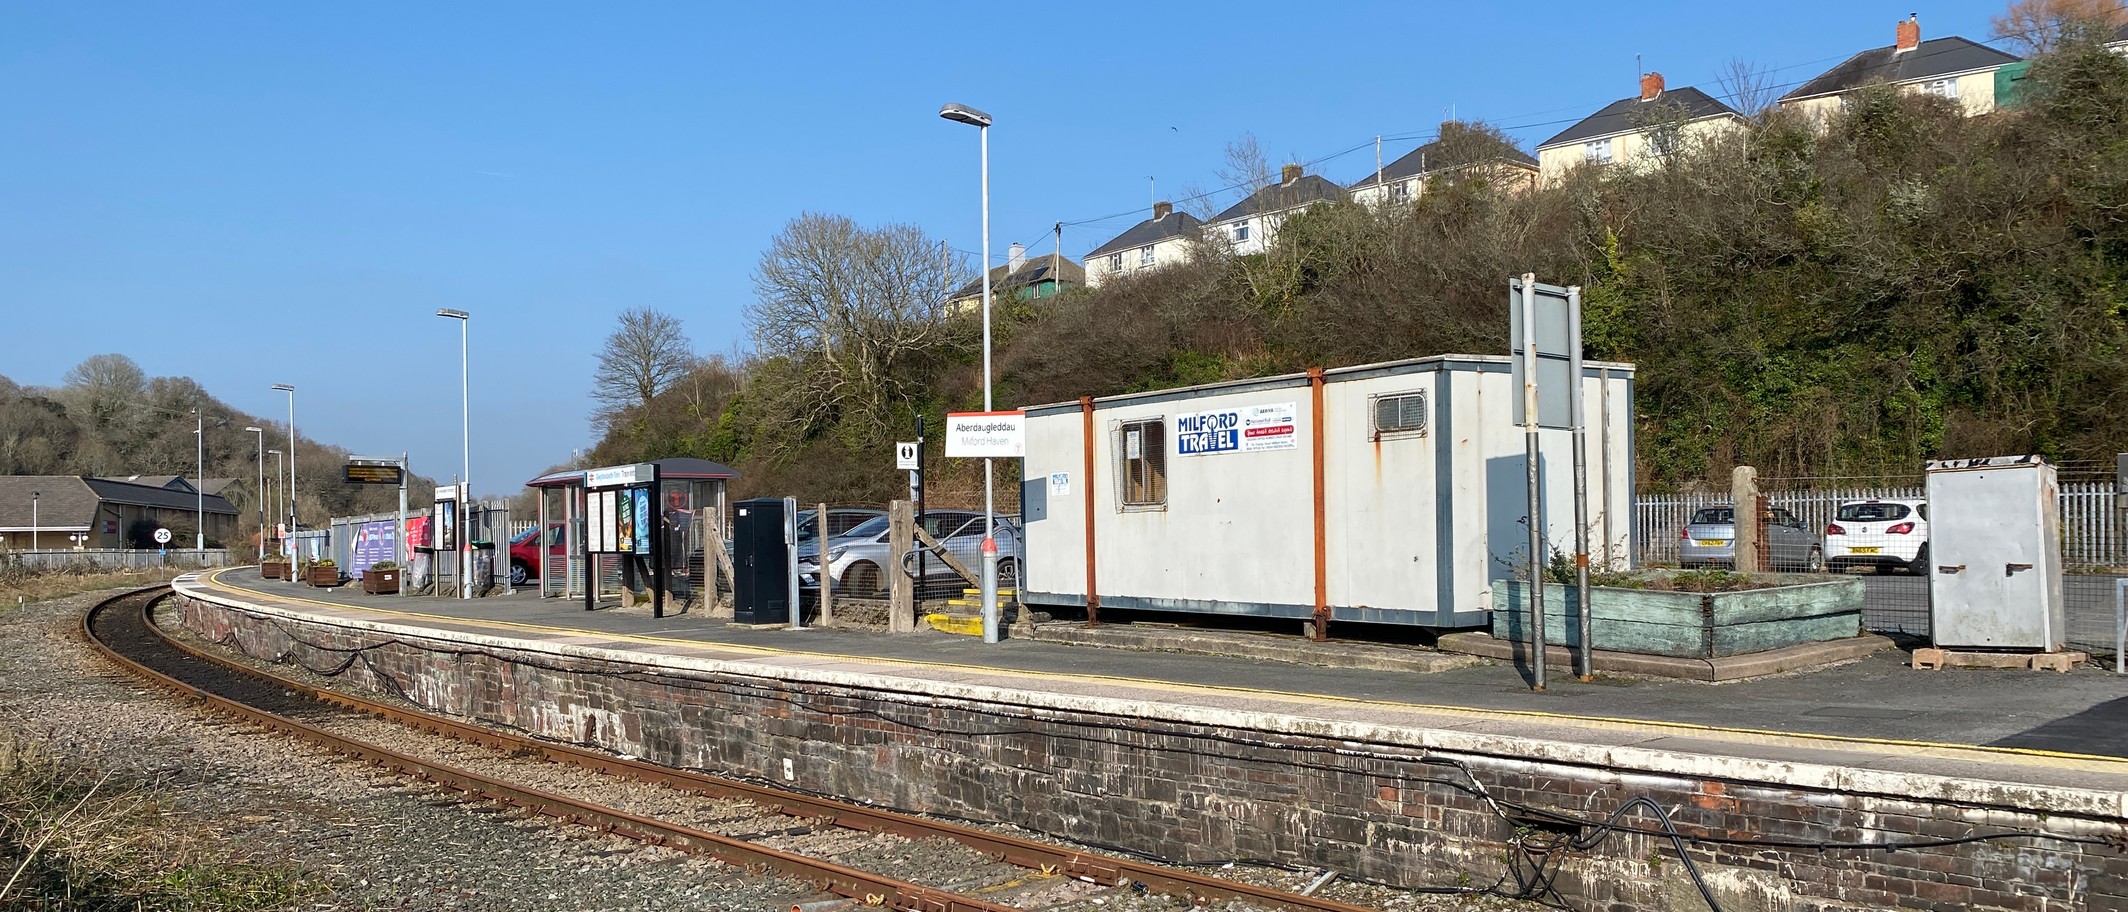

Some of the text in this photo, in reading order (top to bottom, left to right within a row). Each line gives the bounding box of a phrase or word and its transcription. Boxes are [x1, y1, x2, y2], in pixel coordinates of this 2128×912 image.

[956, 422, 1016, 434] Aberdaugleddau
[1178, 412, 1238, 432] MILFORD
[961, 436, 1009, 446] Milford Haven
[1181, 431, 1235, 452] TRAVEL
[157, 531, 169, 540] 25
